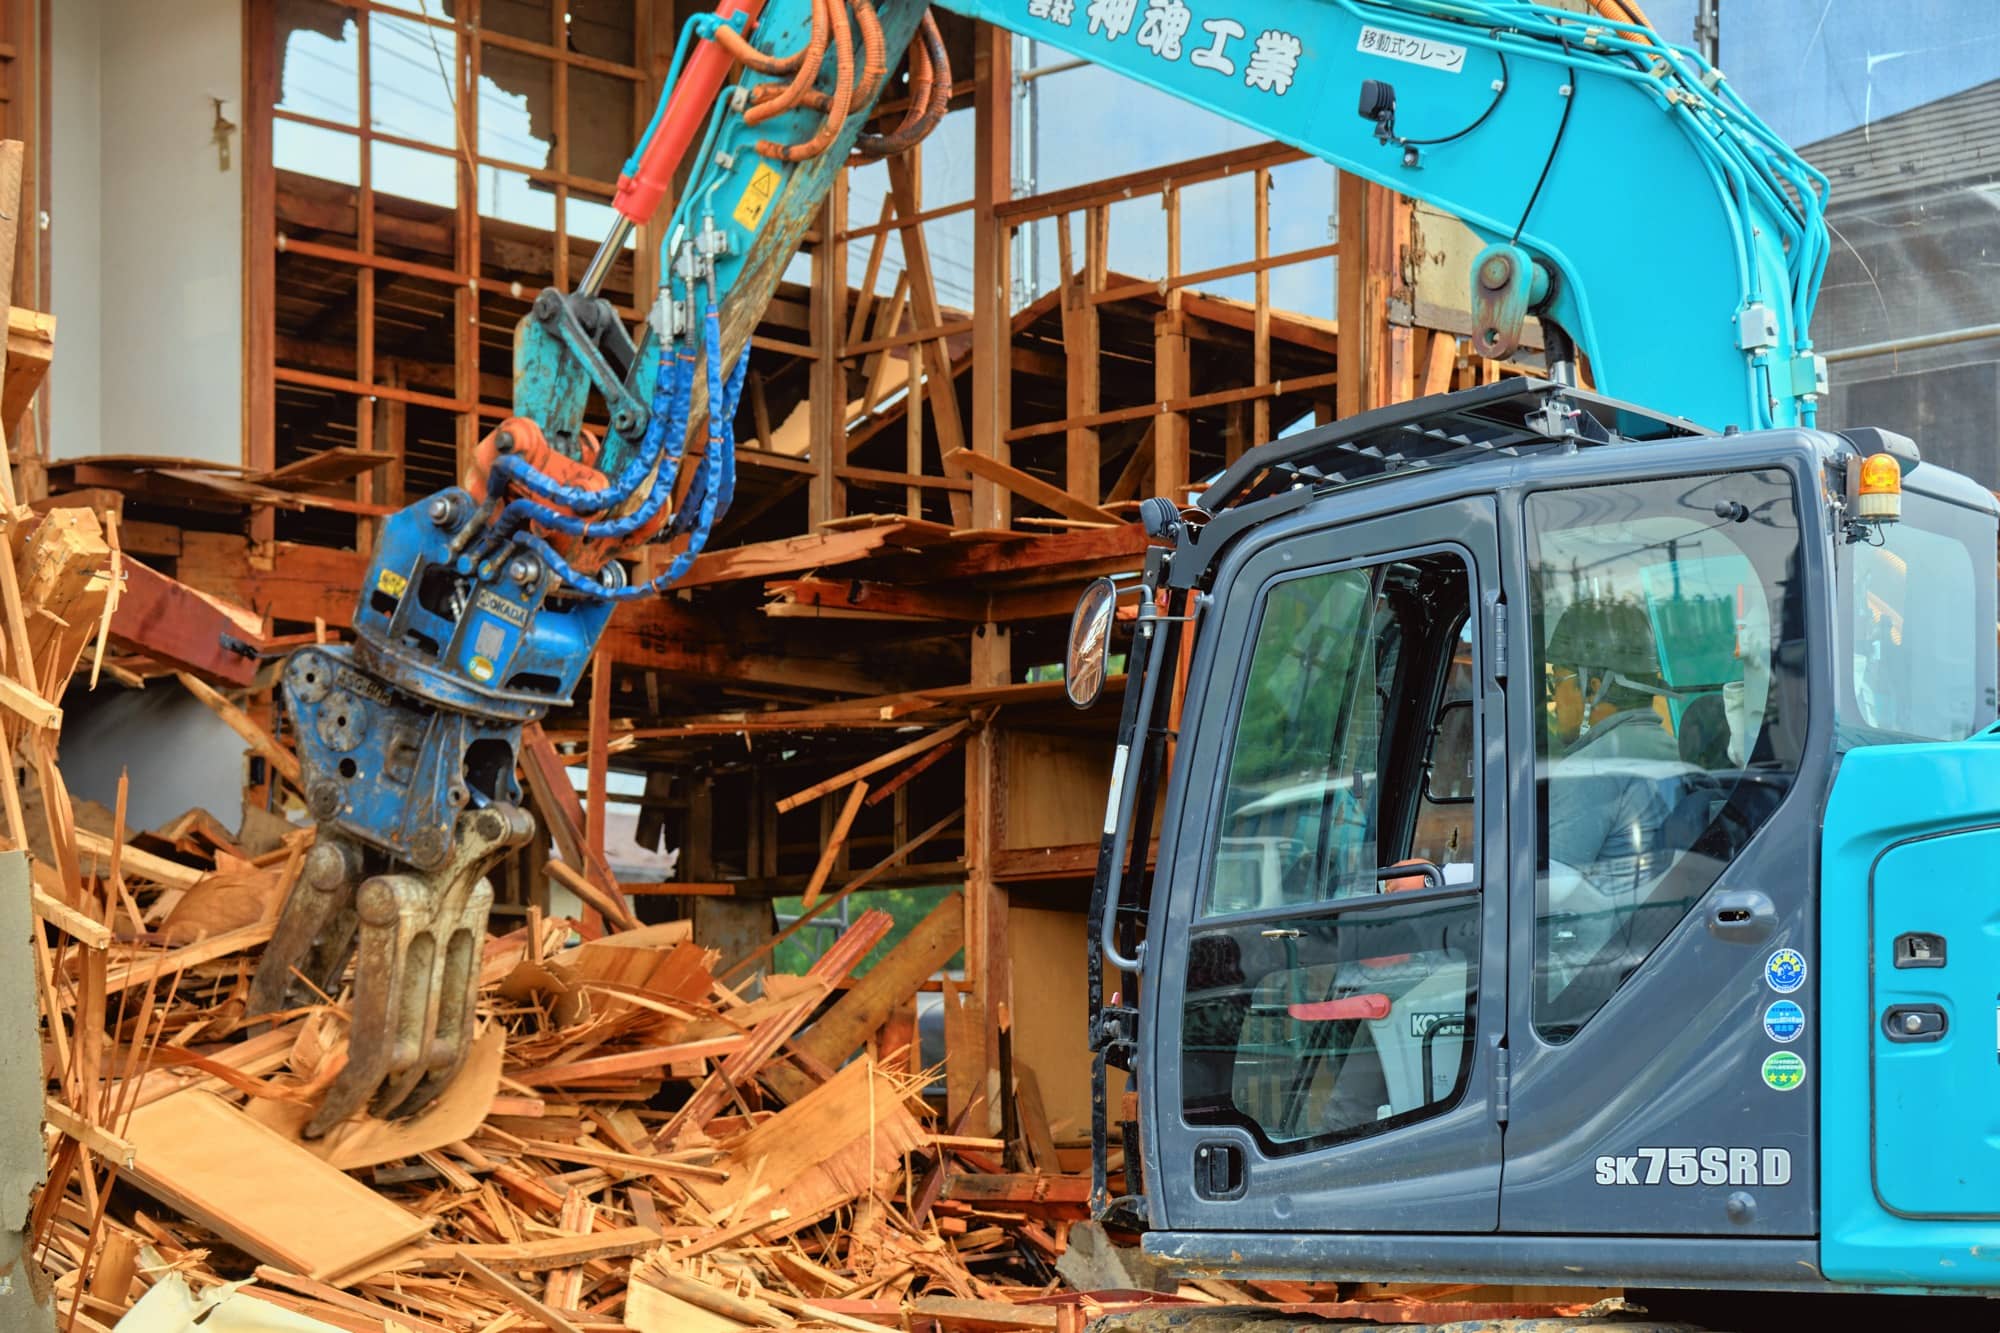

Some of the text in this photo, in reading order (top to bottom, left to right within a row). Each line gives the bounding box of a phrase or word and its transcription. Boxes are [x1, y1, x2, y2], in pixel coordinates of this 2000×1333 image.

[1362, 29, 1462, 66] 移動式クレーン
[489, 598, 527, 623] OKADA
[1595, 1147, 1792, 1185] SK75SRD
